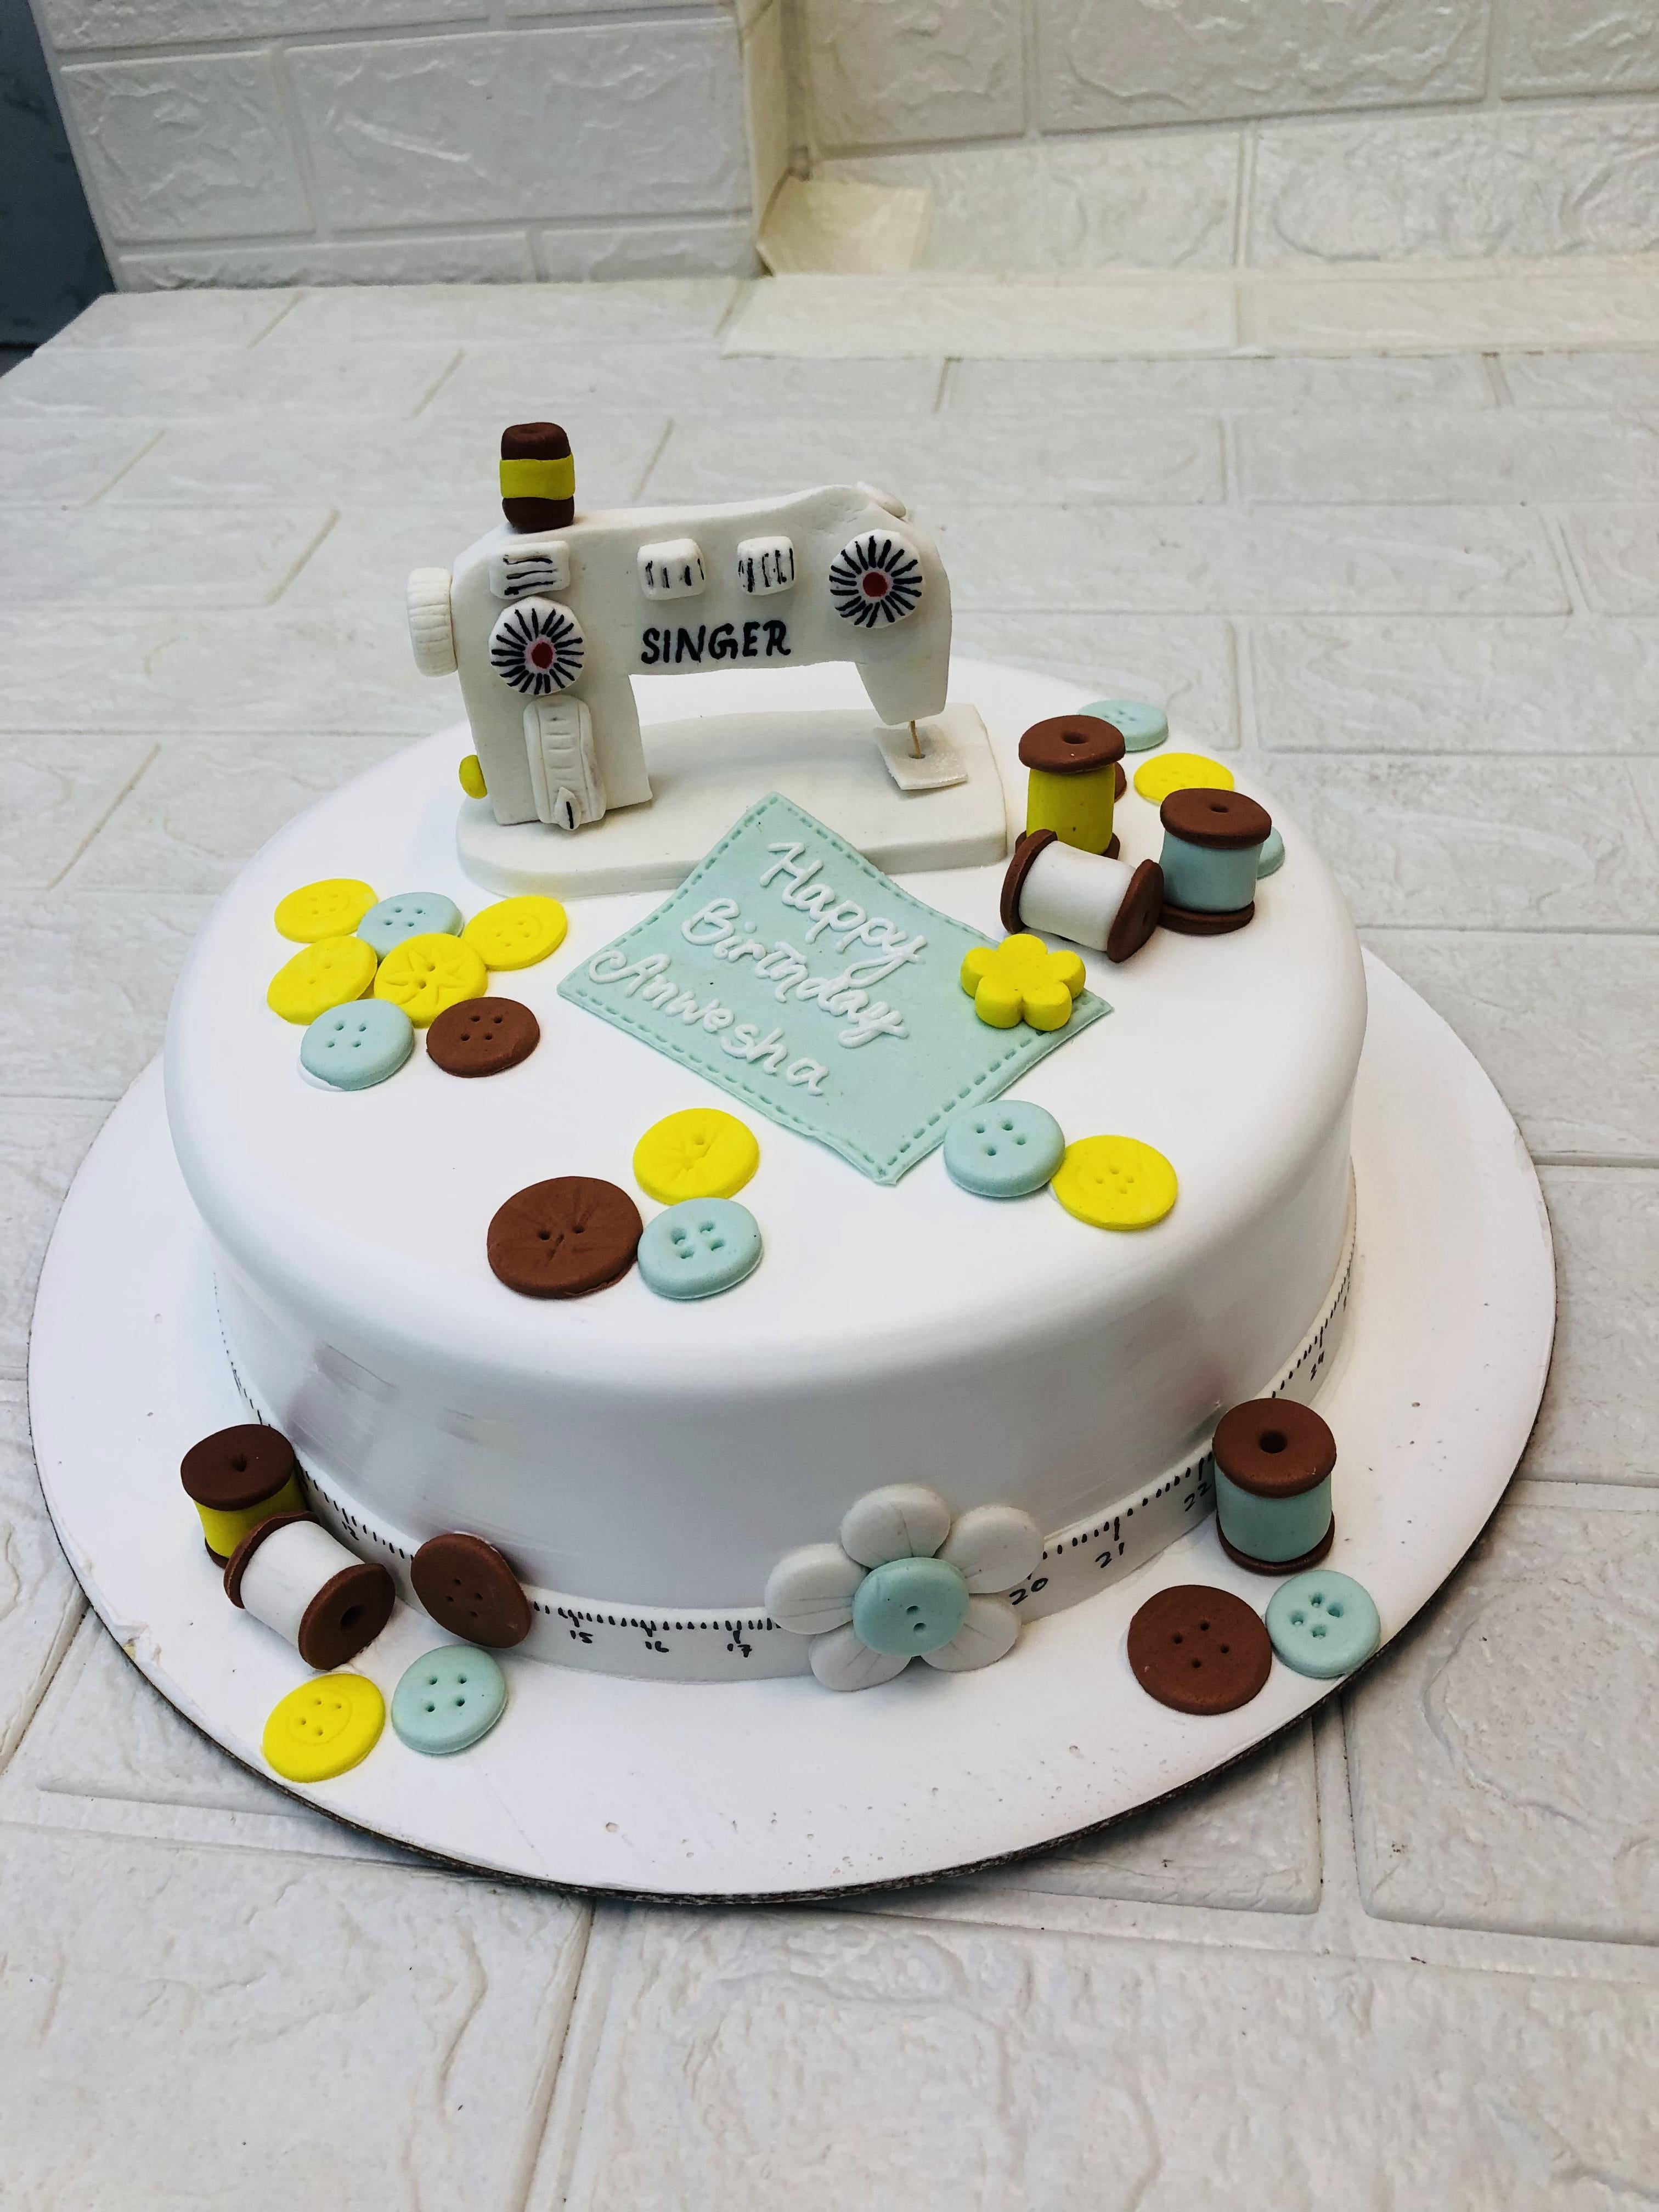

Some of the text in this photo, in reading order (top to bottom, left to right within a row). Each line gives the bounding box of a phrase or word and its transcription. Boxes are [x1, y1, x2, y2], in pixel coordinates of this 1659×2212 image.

[641, 620, 791, 664] SINGER
[681, 898, 909, 1048] Birthday
[759, 842, 927, 988] Happy
[589, 950, 829, 1096] Anwesha
[727, 1643, 752, 1658] 17
[1009, 1577, 1048, 1605] 20
[1095, 1542, 1125, 1568] 21
[1184, 1482, 1213, 1512] 22
